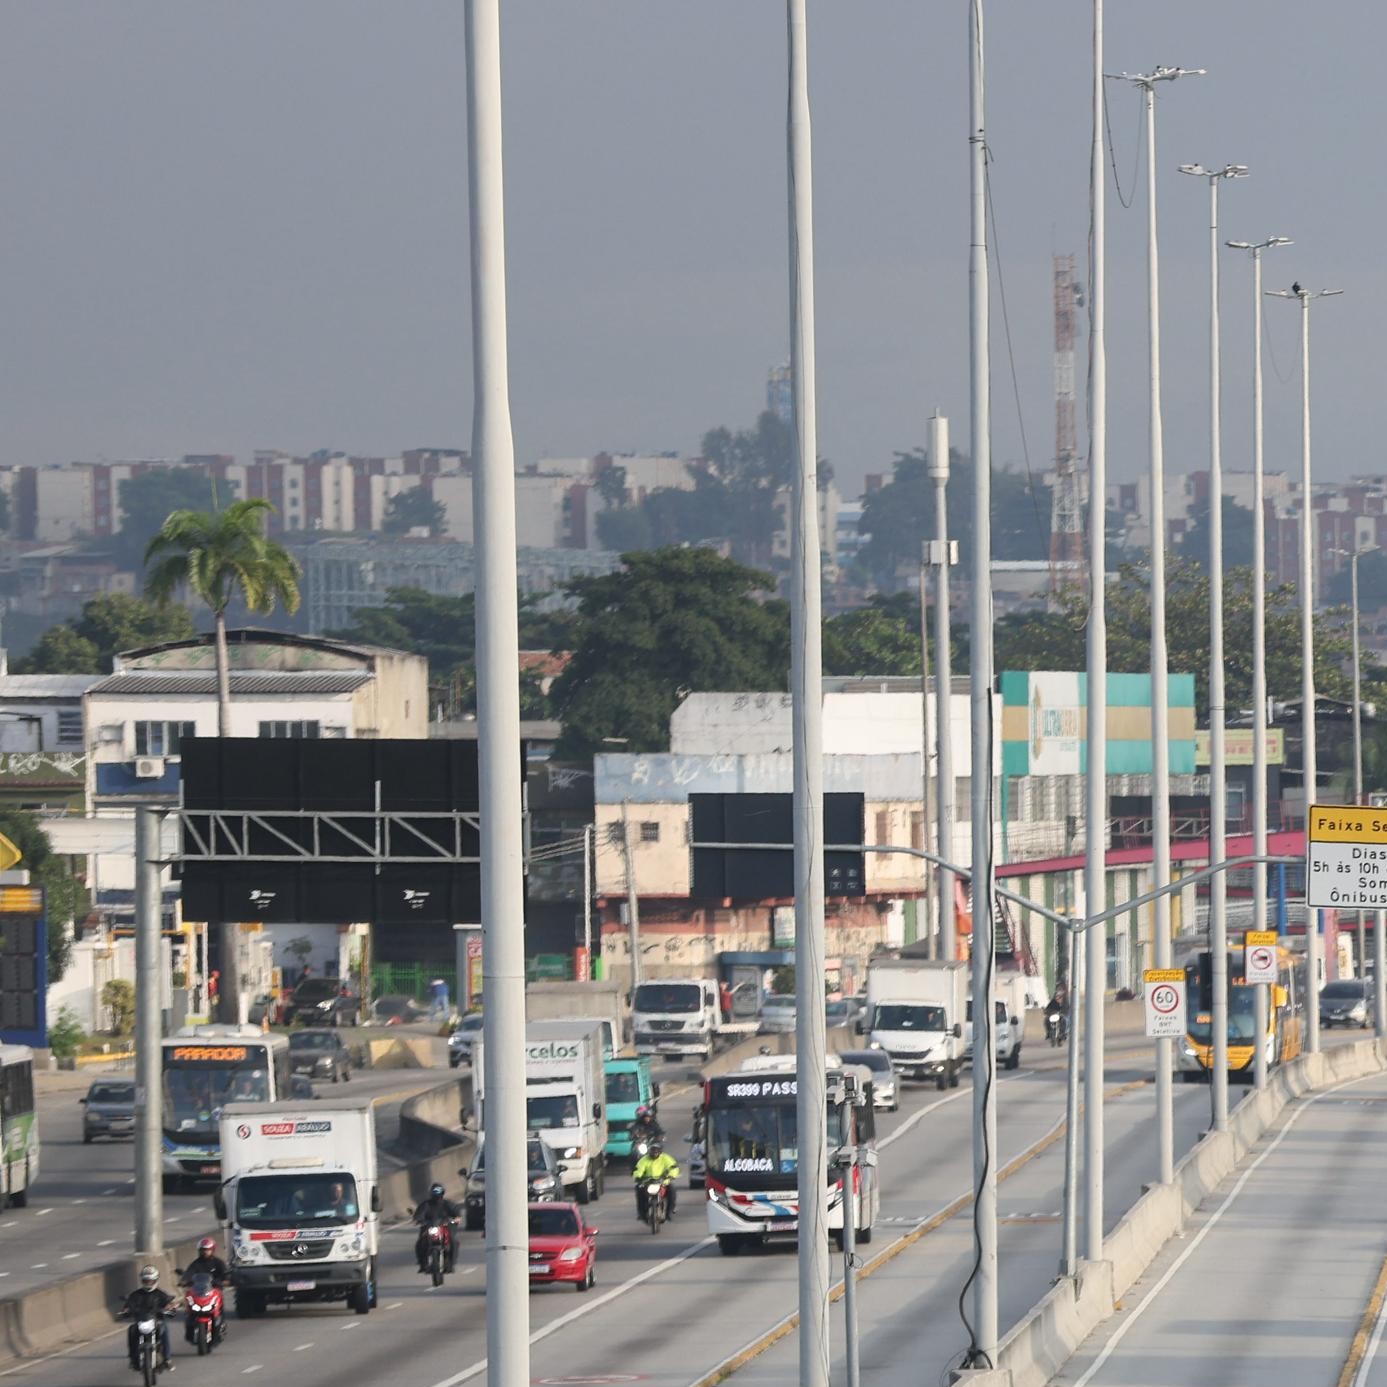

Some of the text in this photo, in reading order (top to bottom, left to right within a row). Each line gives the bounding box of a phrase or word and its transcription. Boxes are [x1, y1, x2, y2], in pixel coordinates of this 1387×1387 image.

[1318, 818, 1363, 832] Faixa
[1352, 848, 1387, 861] Dias
[1313, 861, 1329, 872] 5h
[1336, 861, 1351, 873] às
[1359, 862, 1379, 875] 10h
[1330, 887, 1387, 904] Ônibus
[1156, 991, 1174, 1004] 60
